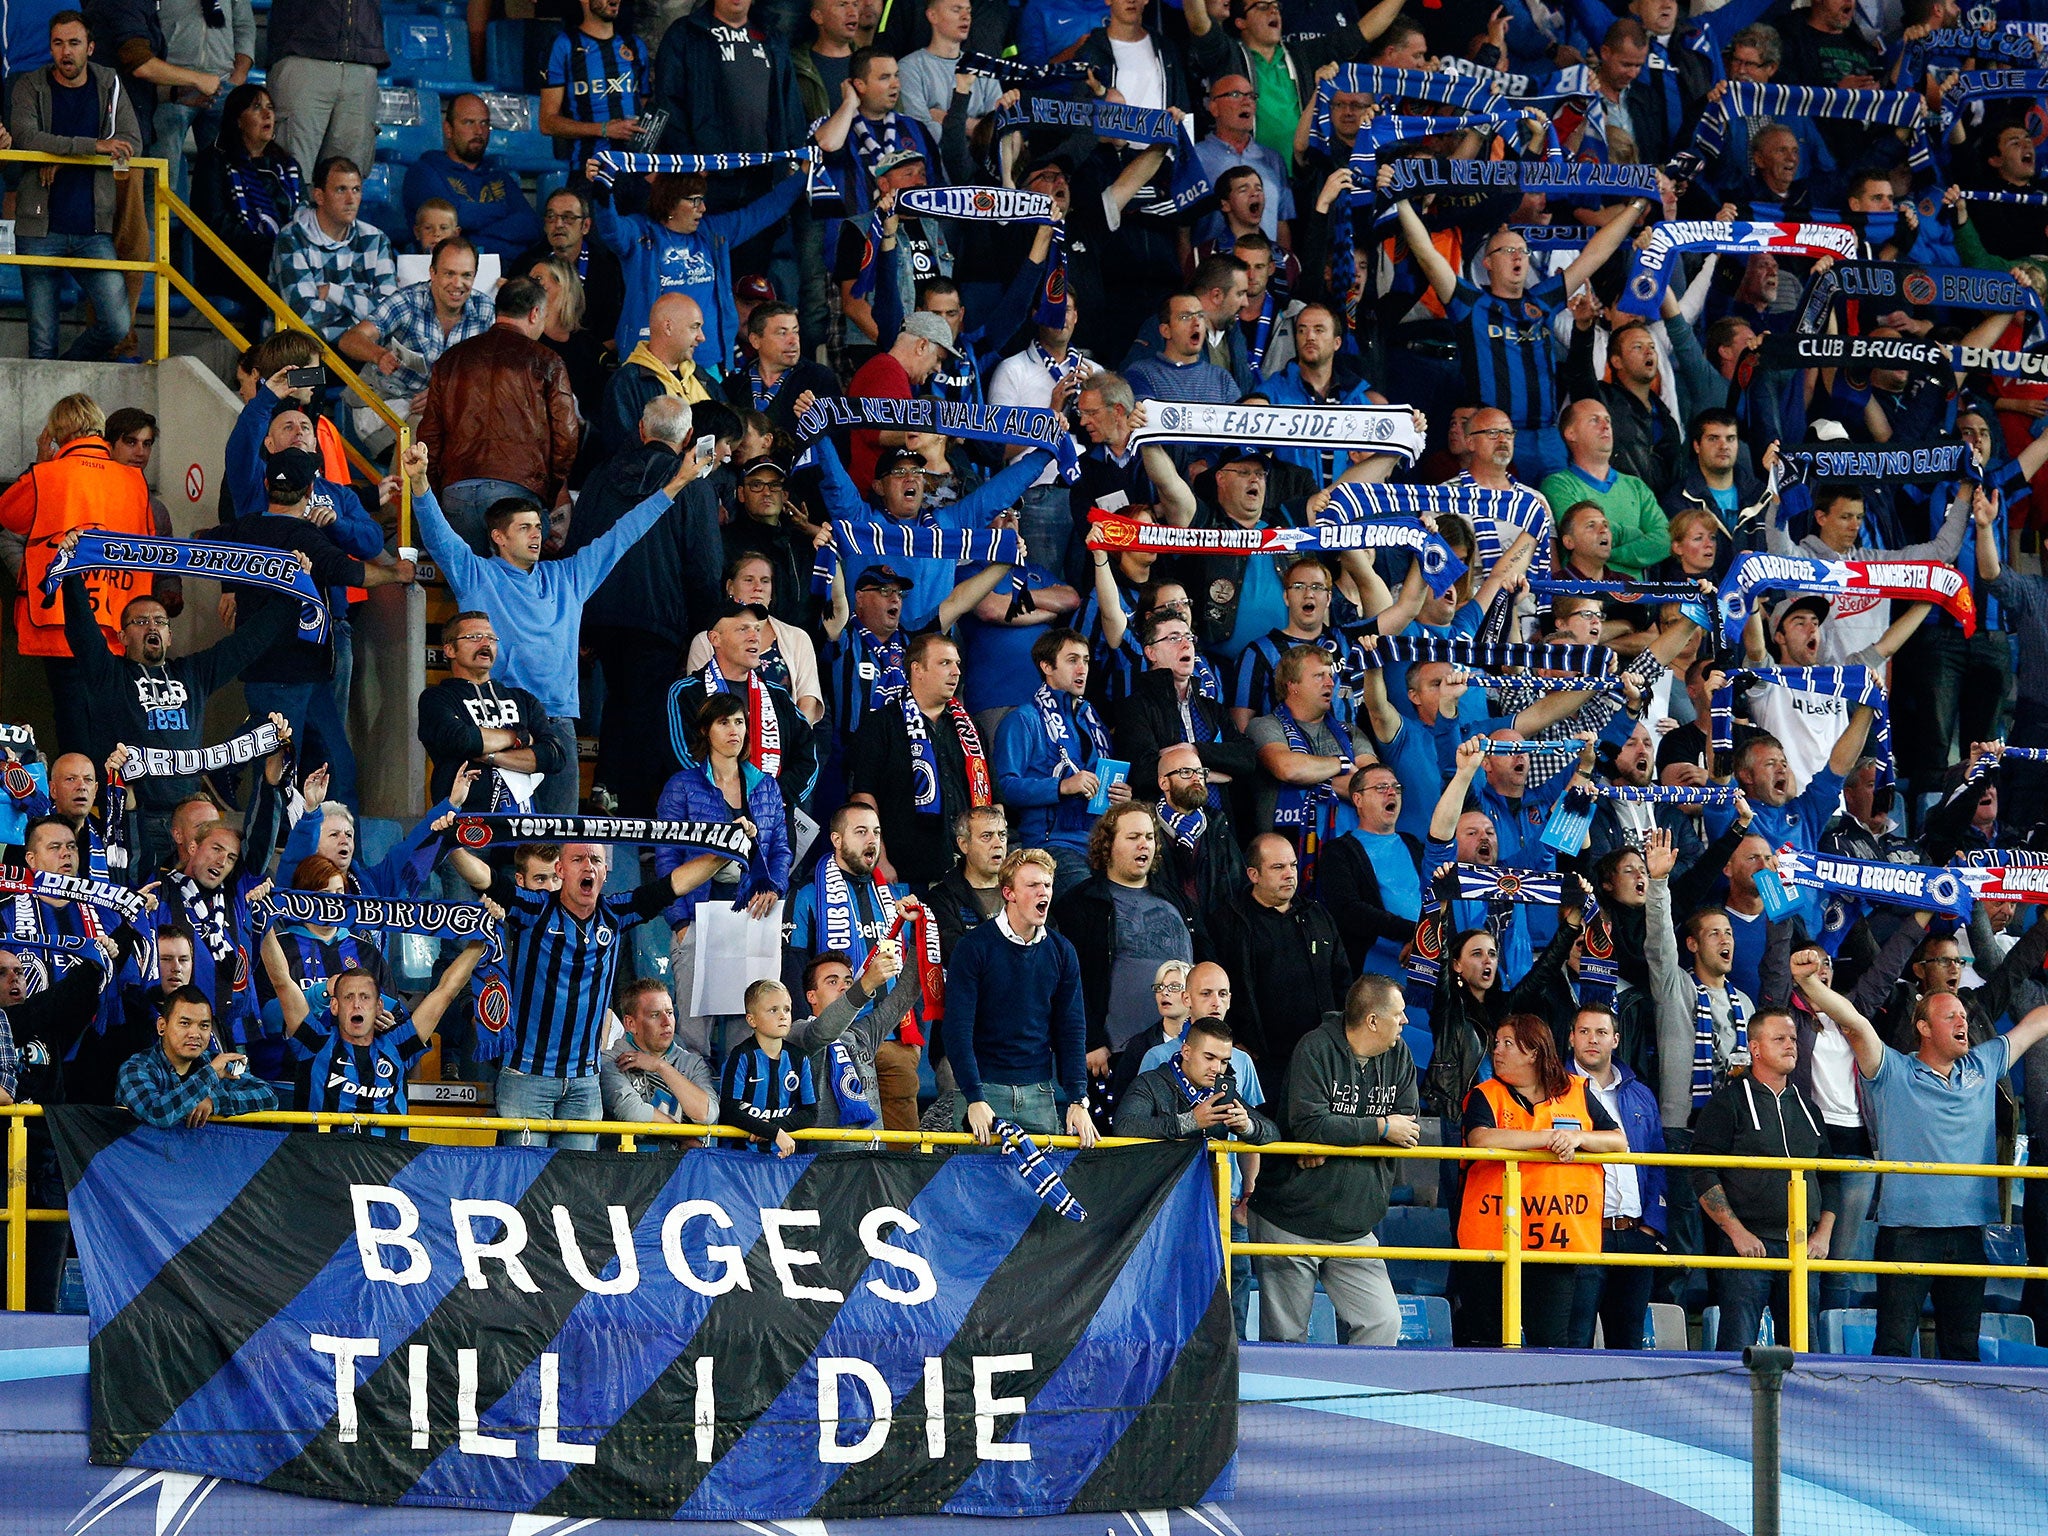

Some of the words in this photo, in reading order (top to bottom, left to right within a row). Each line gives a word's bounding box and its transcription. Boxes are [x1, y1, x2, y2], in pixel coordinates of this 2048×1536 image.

[1031, 97, 1093, 127] NEVER
[1449, 159, 1518, 186] NEVER
[1523, 161, 1581, 187] WALK
[1177, 180, 1210, 207] 2012
[1640, 230, 1674, 271] CLUB
[1663, 220, 1734, 247] BRUGGE
[1840, 266, 1896, 296] CLUB
[1942, 274, 2026, 307] BRUGGE
[1798, 338, 1845, 358] CLUB
[1850, 339, 1942, 366] BRUGGE
[862, 397, 933, 426] NEVER
[938, 400, 999, 434] WALK
[1223, 410, 1338, 439] EAST-SIDE
[1913, 445, 1965, 475] GLORY
[1138, 524, 1220, 549] MANCHESTER
[1219, 528, 1263, 550] UNITED
[1318, 525, 1365, 550] CLUB
[1364, 524, 1426, 553] BRUGGE
[102, 541, 181, 569] CLUB
[187, 545, 302, 587] BRUGGE
[416, 566, 434, 579] -40
[1865, 563, 1928, 589] MANCHESTER
[1928, 564, 1965, 599] UNITED
[147, 708, 190, 732] 1891
[463, 698, 520, 726] FCB
[121, 721, 282, 782] BRUGGE
[507, 817, 578, 839] YOU'LL
[583, 818, 644, 841] NEVER
[650, 821, 706, 845] WALK
[1815, 859, 1860, 888] CLUB
[1859, 866, 1927, 898] BRUGGE
[826, 905, 851, 951] CLUB
[434, 1087, 475, 1101] 22-40
[1478, 1193, 1590, 1218] STWARD
[350, 1183, 938, 1306] BRUGES
[1526, 1221, 1570, 1250] 54
[310, 1333, 597, 1465] TILL
[694, 1356, 716, 1463] I
[816, 1352, 1034, 1465] DIE
